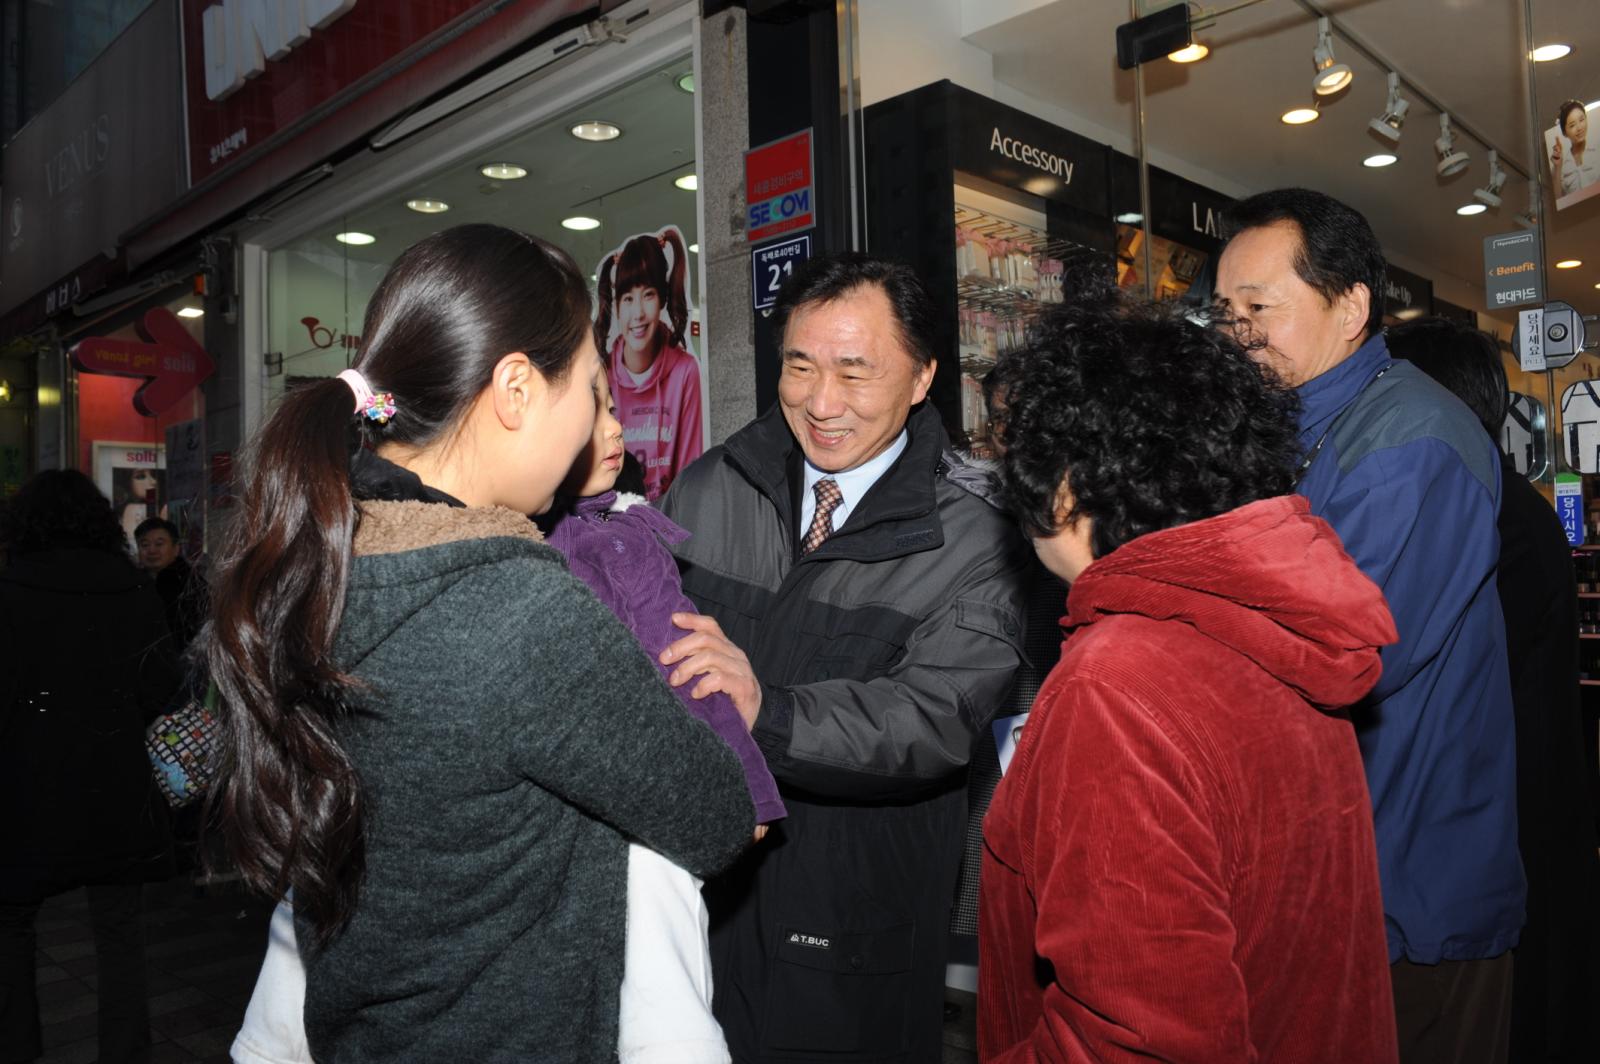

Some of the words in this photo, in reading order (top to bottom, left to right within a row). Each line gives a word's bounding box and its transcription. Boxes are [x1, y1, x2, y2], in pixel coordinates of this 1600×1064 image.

[43, 113, 110, 198] VENUS
[990, 127, 1074, 184] Accessory
[750, 189, 809, 228] SECOM
[768, 260, 793, 291] 21
[1495, 261, 1536, 277] Benefit
[1495, 287, 1537, 304] 현대카드
[1527, 312, 1541, 356] 당기세요
[1563, 497, 1577, 542] 당기시오
[801, 935, 829, 946] T.BUC
